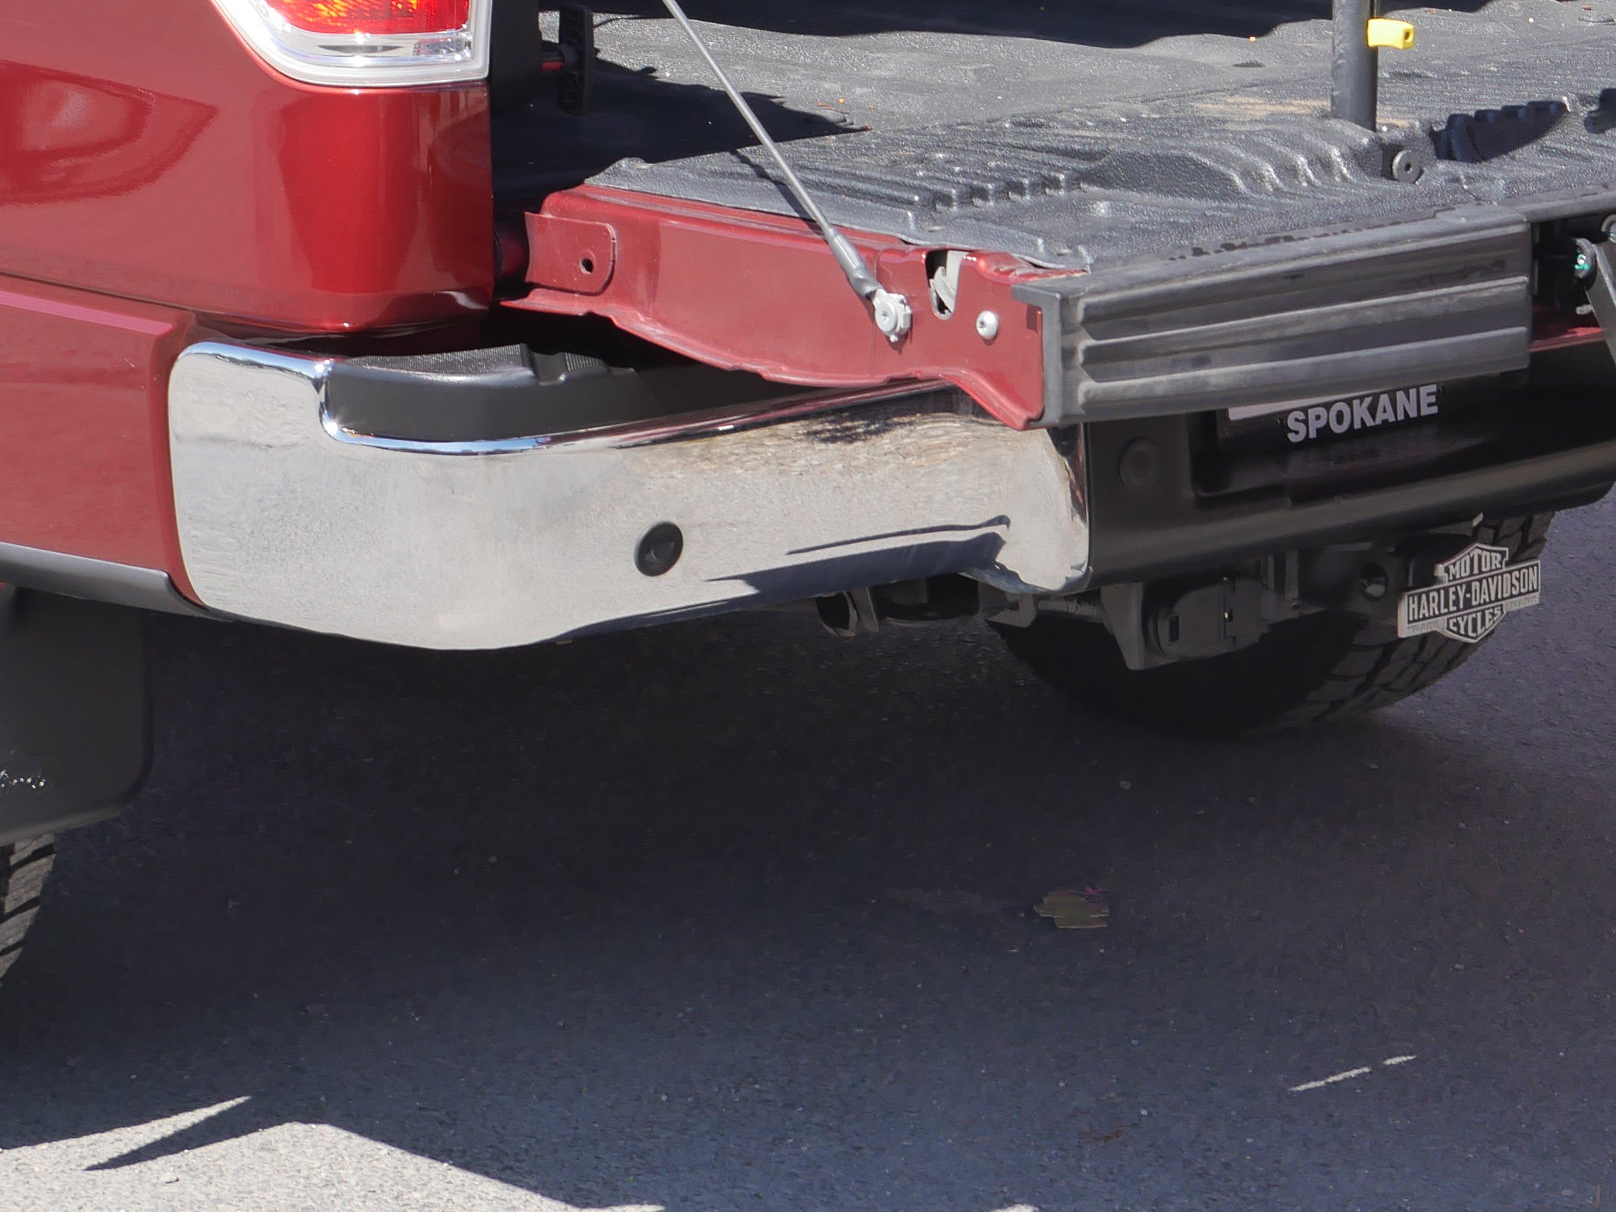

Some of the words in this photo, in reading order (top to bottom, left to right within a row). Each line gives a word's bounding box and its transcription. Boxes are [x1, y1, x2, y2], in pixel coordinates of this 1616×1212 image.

[1287, 384, 1439, 443] SPOKANE
[1448, 548, 1501, 580] MOTOR
[1408, 565, 1538, 622] HARLEY-DAVIDSON
[1449, 606, 1501, 637] CYCLES
